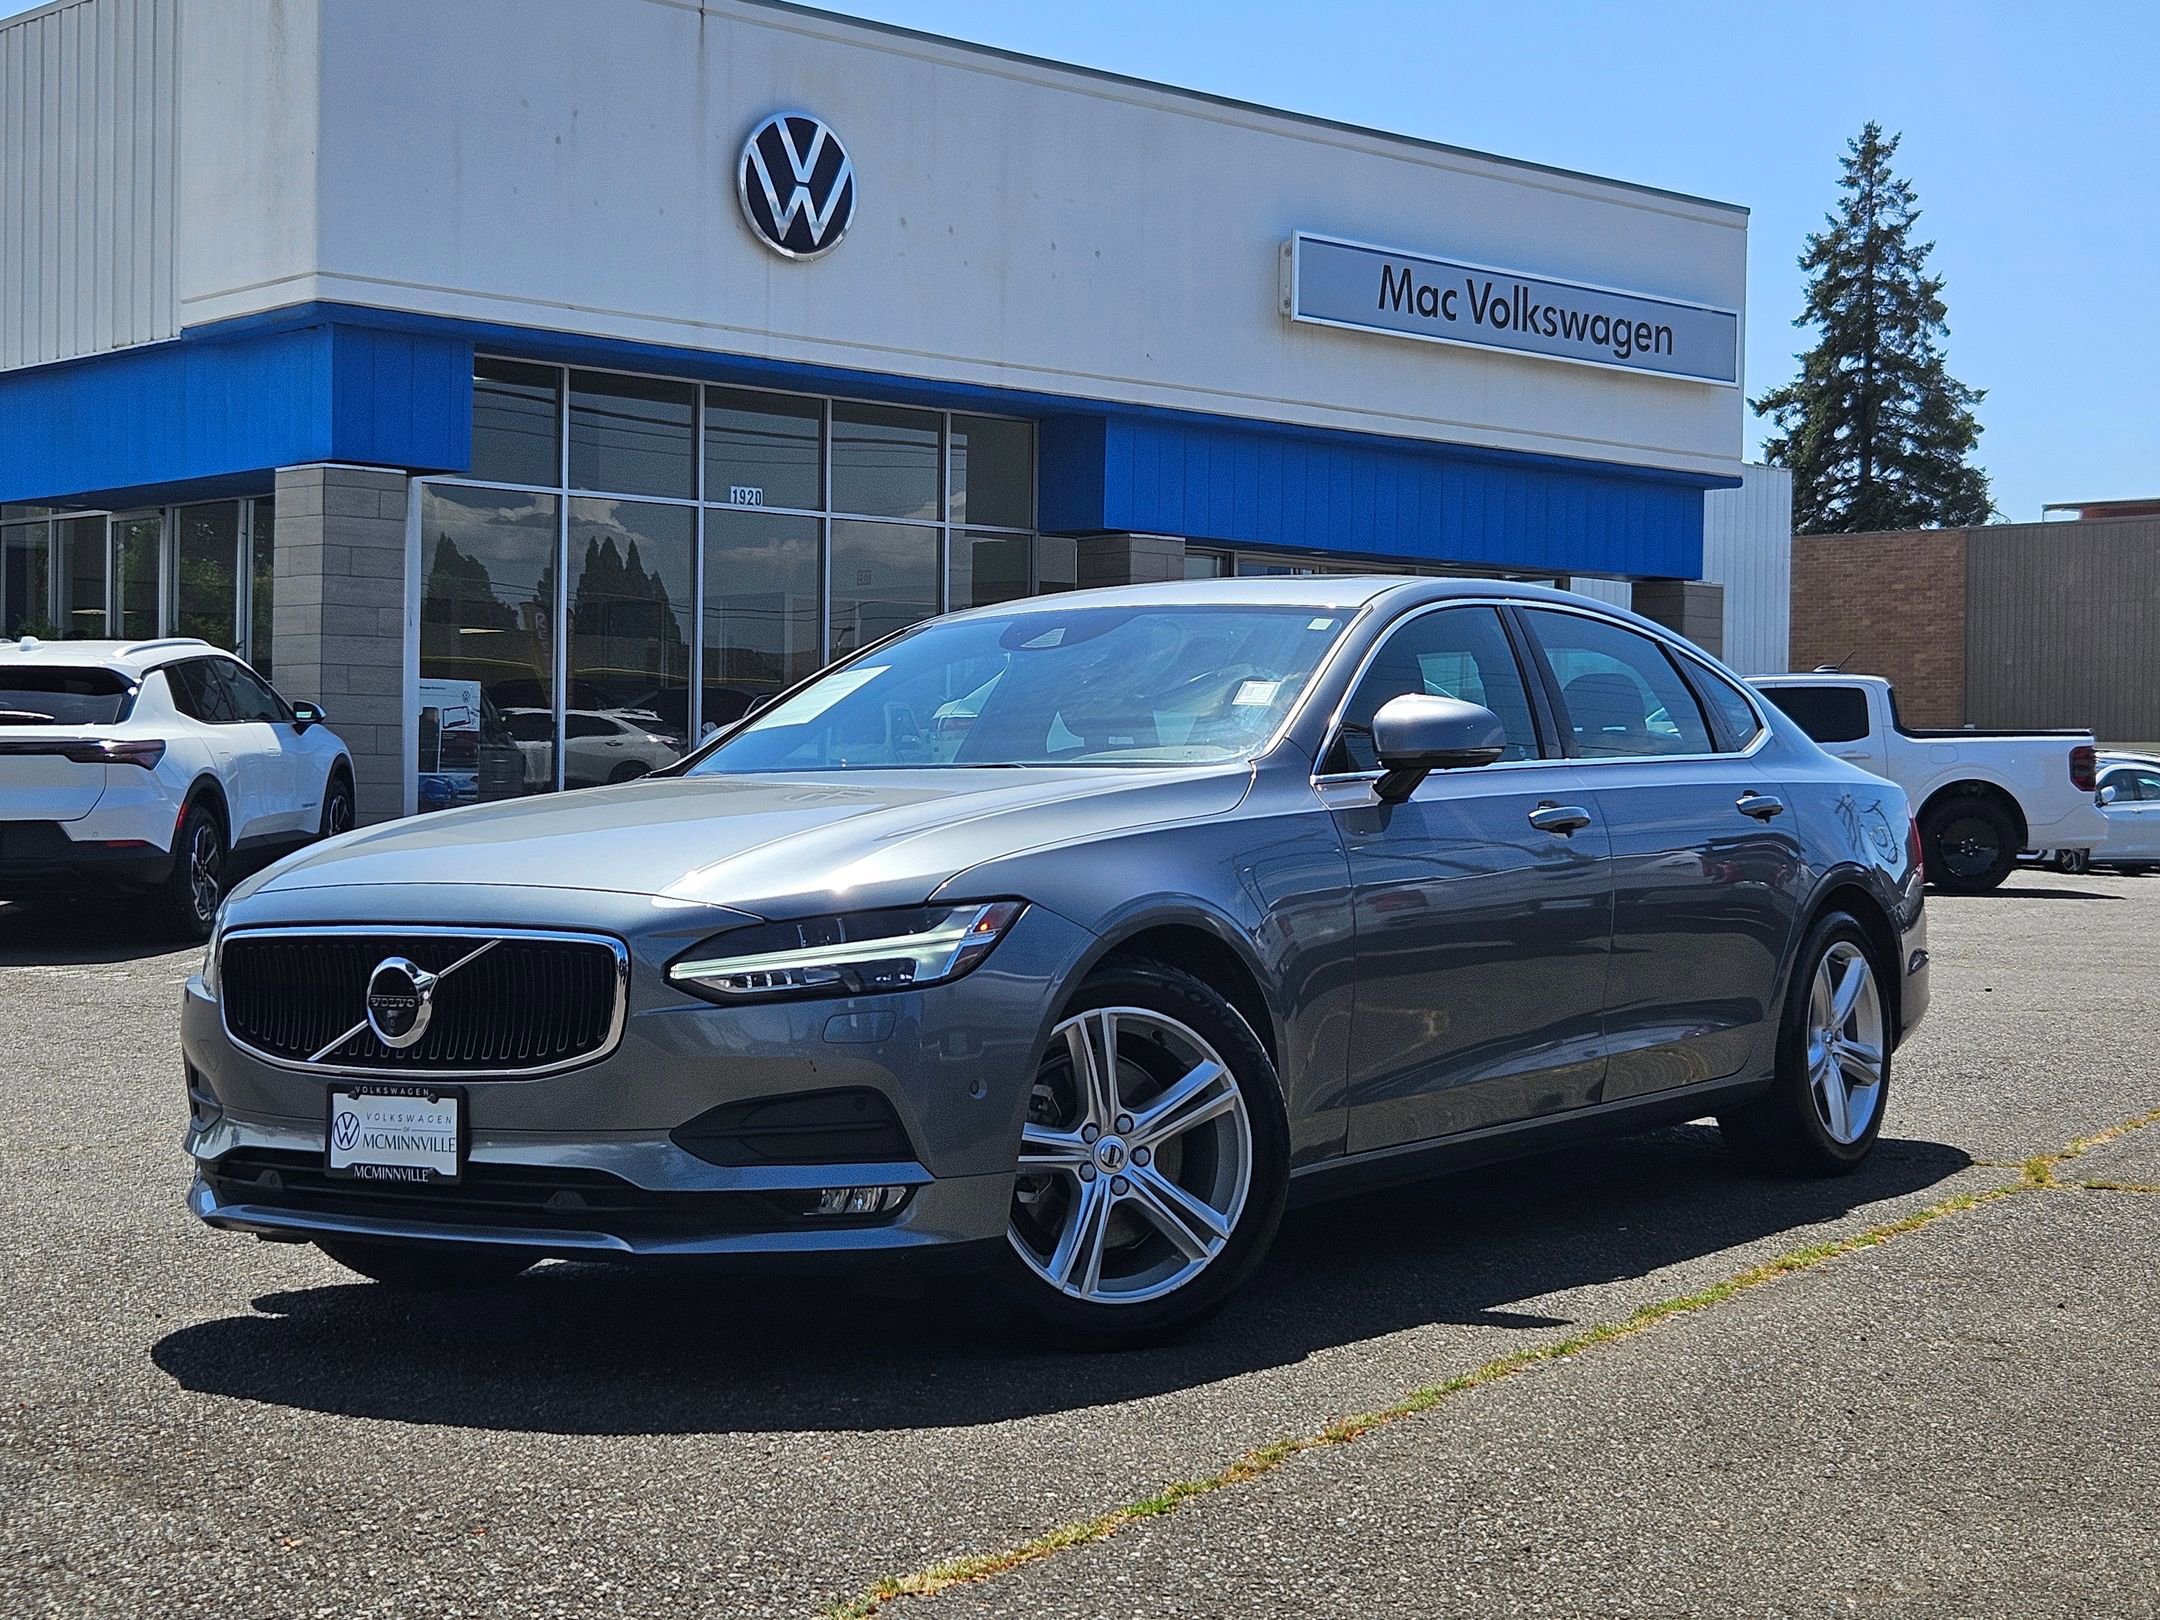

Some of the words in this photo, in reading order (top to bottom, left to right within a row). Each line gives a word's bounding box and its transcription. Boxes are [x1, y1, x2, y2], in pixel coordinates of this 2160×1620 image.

[1378, 264, 1457, 322] Mac
[1466, 278, 1673, 359] Volkswagen
[732, 488, 762, 506] 1920
[370, 997, 415, 1008] VOLVO
[355, 1085, 429, 1096] VOLKSWAGEN
[366, 1112, 453, 1124] VOLKSWAGEN
[362, 1133, 456, 1153] MCMINNVILLE
[353, 1164, 429, 1182] MCMINNVILLE
